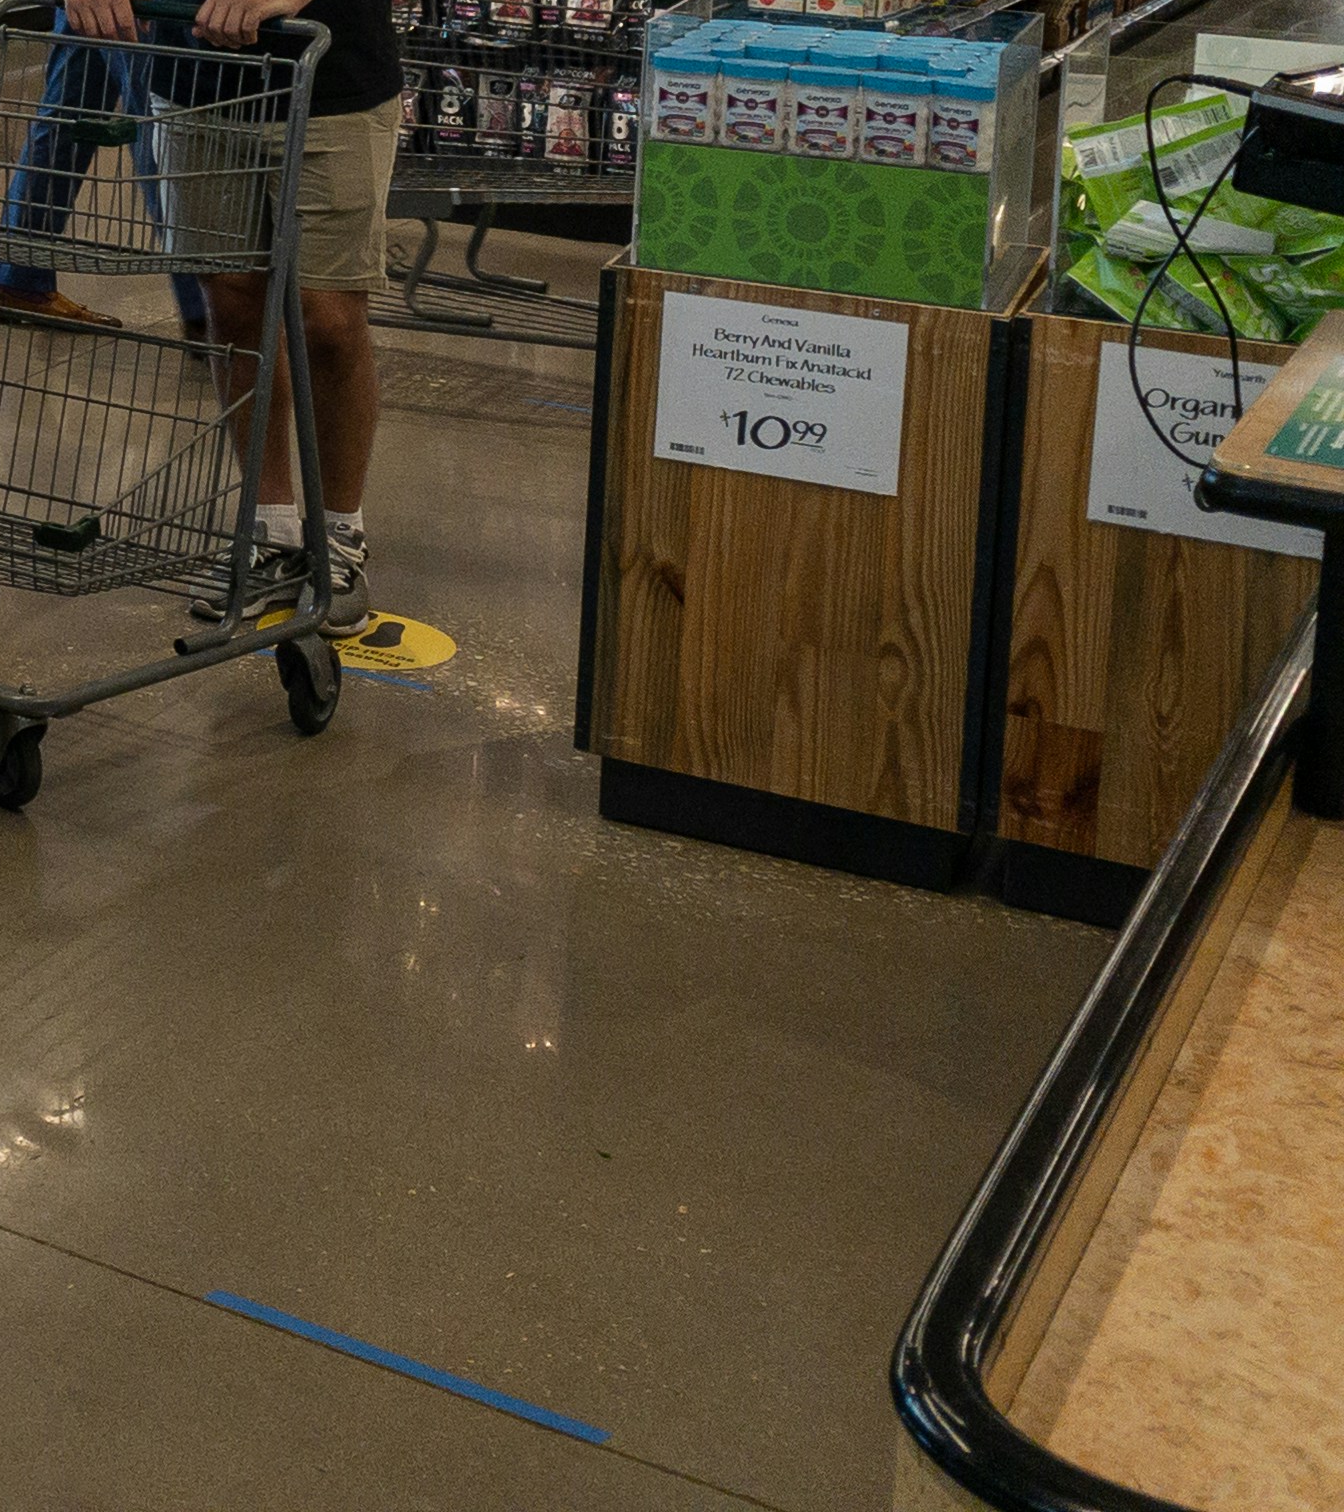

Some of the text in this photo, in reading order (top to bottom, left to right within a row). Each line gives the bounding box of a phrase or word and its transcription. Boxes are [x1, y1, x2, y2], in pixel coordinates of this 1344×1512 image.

[440, 86, 461, 113] 8
[437, 114, 464, 126] PACK
[612, 114, 629, 139] 8
[762, 314, 799, 327] Genexa
[714, 327, 851, 359] Berry And Vanilla
[692, 344, 872, 380] Heartburn Fix Anatacid
[724, 366, 837, 395] 72 Chewables
[1143, 387, 1237, 421] Organ
